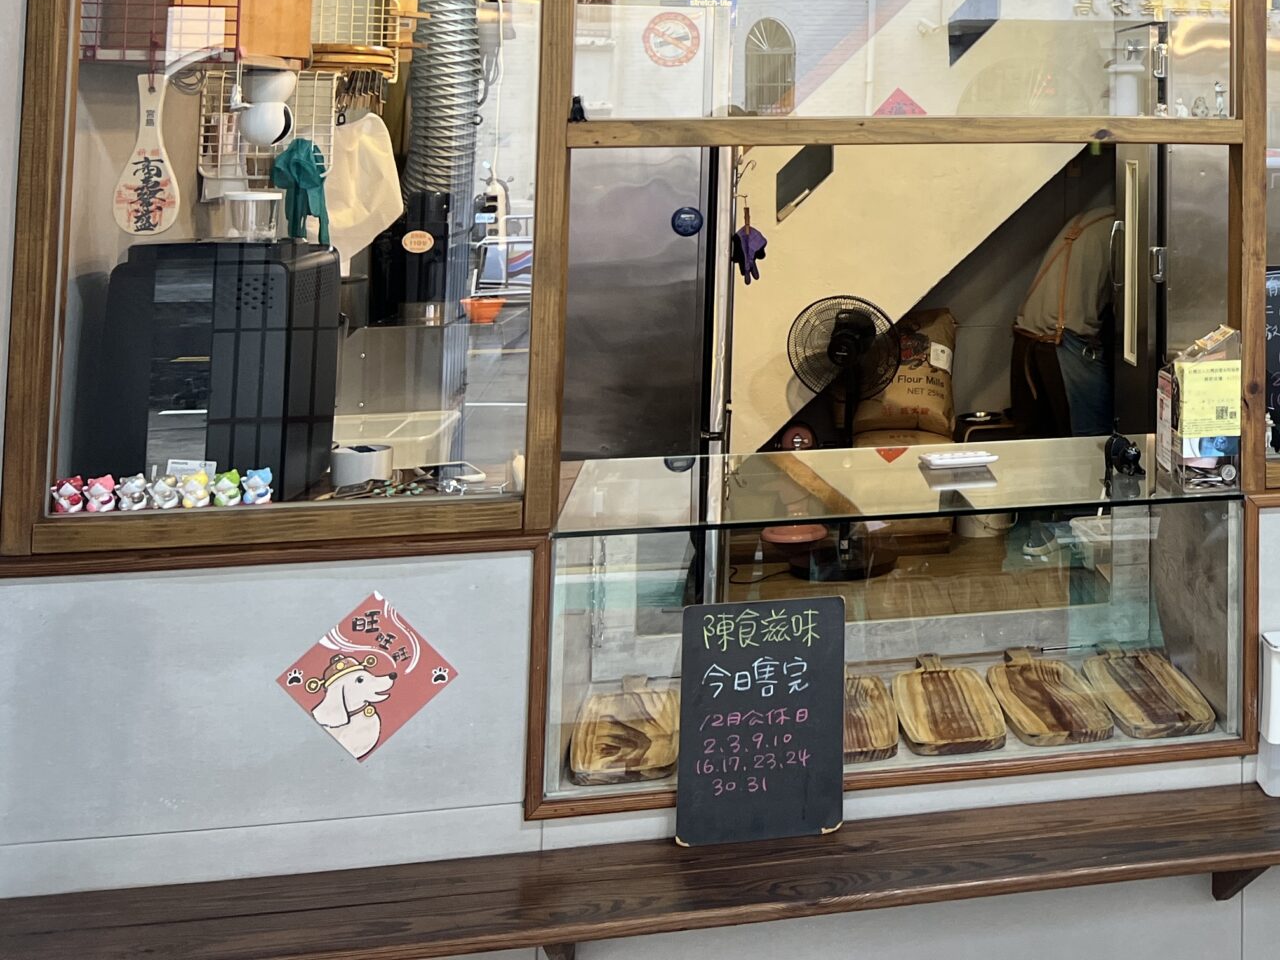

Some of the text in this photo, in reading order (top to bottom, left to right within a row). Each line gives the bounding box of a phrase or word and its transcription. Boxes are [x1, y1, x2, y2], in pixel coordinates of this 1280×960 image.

[897, 374, 924, 385] Flour
[926, 376, 945, 388] Mills
[907, 388, 925, 396] NET
[702, 608, 822, 653] 陳食滋味
[701, 656, 809, 700] 今日售完
[699, 707, 810, 733] 12月公休日
